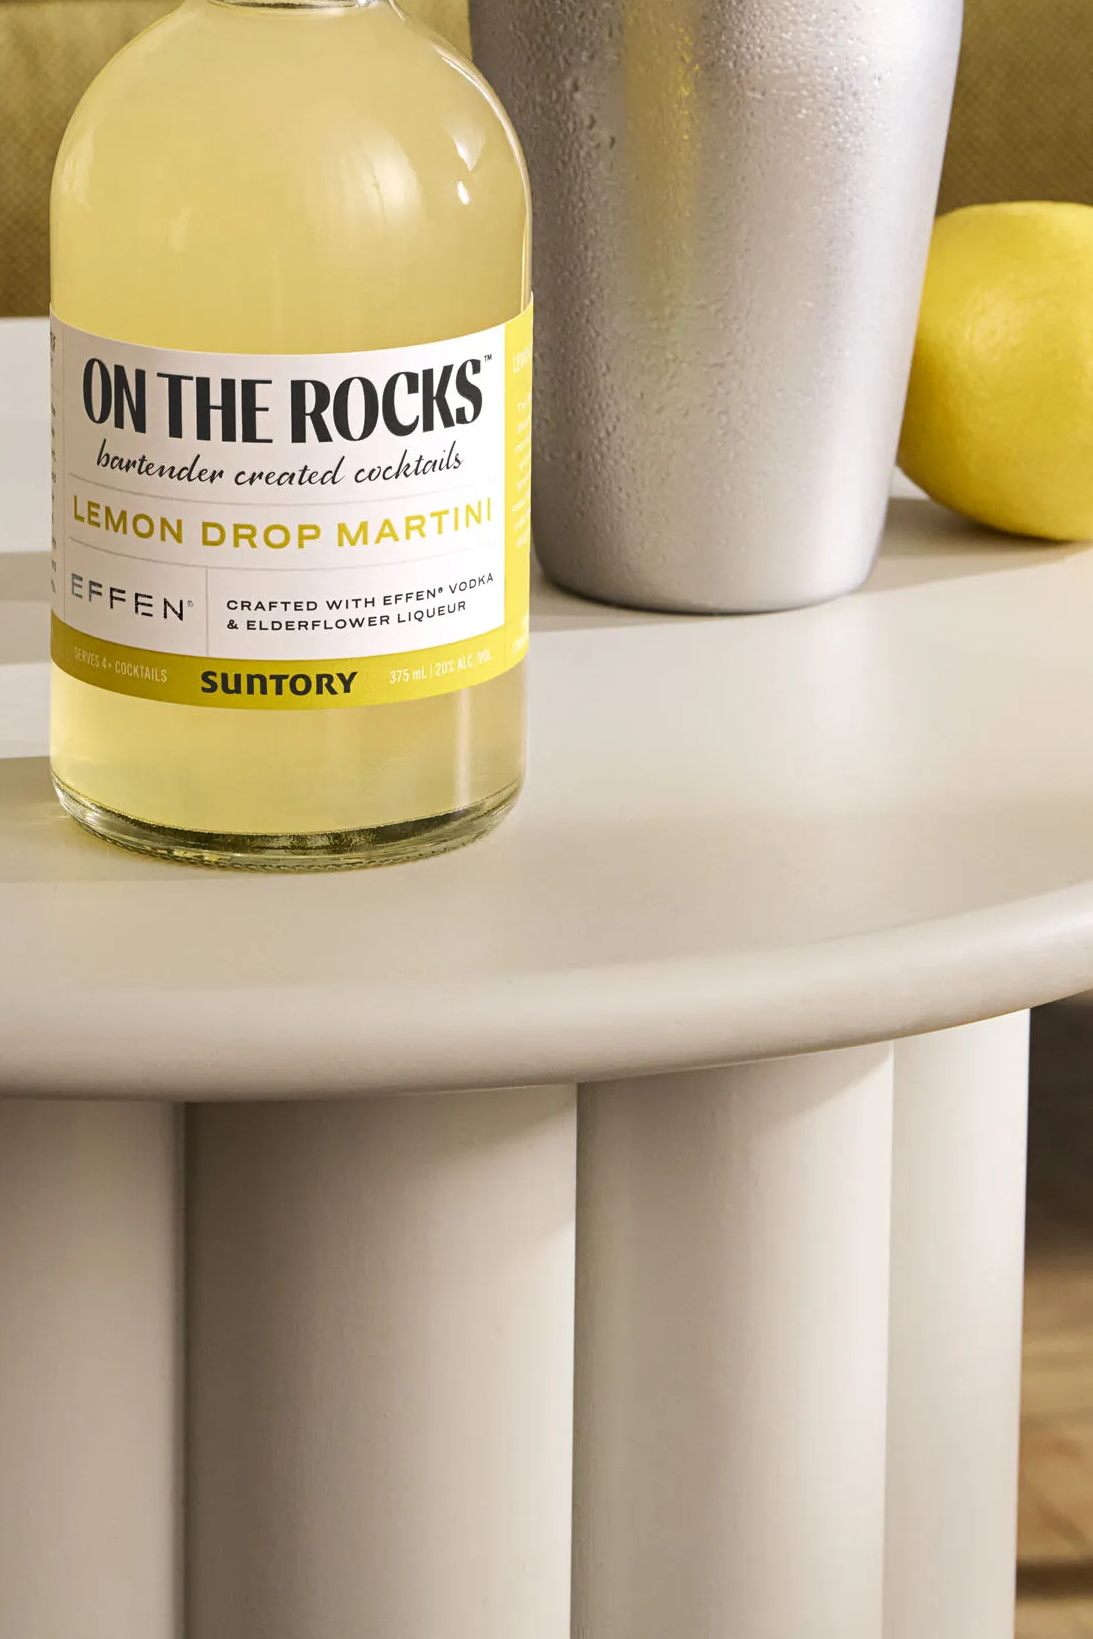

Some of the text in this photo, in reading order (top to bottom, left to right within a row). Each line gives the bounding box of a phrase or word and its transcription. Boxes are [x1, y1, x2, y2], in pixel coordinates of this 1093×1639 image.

[82, 356, 146, 434] ON
[157, 371, 273, 444] THE
[95, 437, 464, 488] bartender created cocktails
[72, 492, 493, 550] LEMON DROP MARTINI
[226, 598, 319, 612] CRAFTED
[325, 597, 376, 611] WITH
[447, 572, 494, 595] VODKA
[226, 600, 467, 632] & ELDERFLOWER LIQUEUR
[74, 646, 100, 668] SERVES
[114, 660, 167, 683] COCKTAILS
[389, 668, 410, 685] 375
[412, 665, 427, 681] mL
[435, 659, 456, 677] 20%
